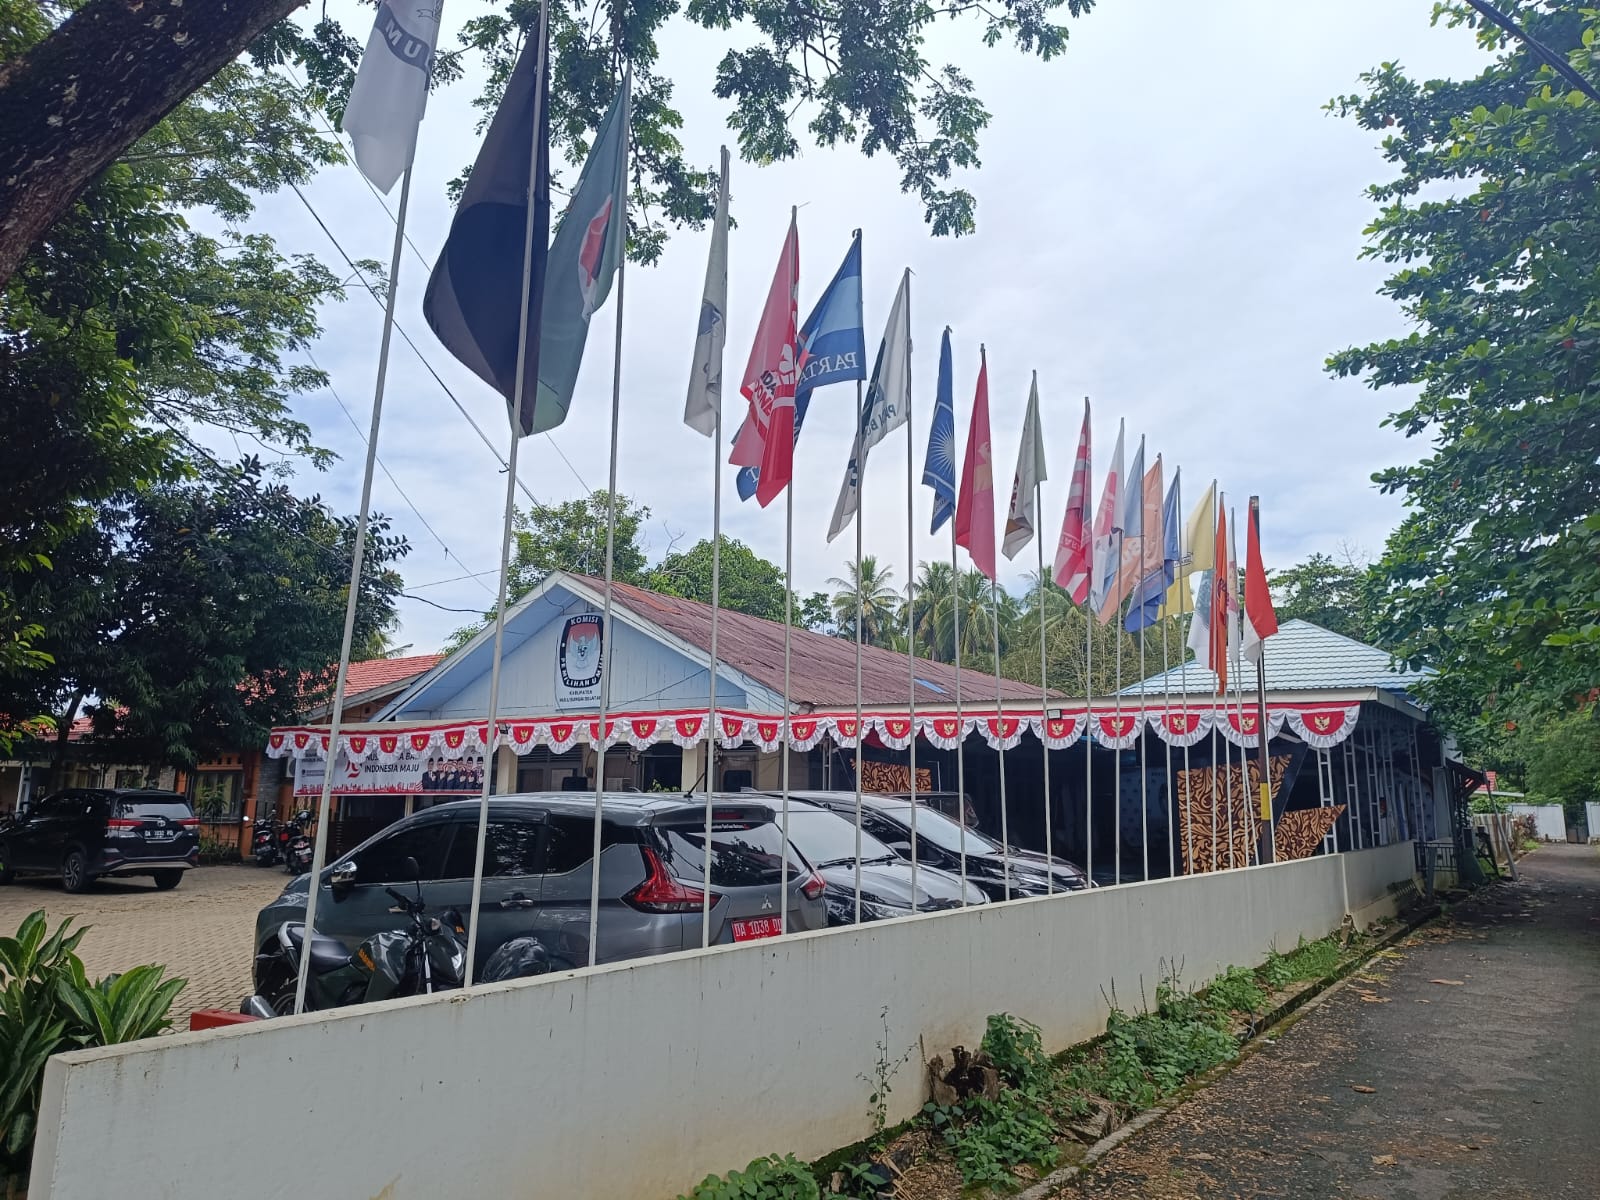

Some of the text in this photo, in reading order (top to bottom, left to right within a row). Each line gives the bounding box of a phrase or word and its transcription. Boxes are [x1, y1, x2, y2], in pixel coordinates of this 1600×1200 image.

[570, 616, 598, 625] KOMISI
[560, 657, 590, 687] PEMILIHAN
[365, 763, 420, 773] INDONESIA MAJU
[733, 922, 746, 937] DA
[749, 920, 770, 935] 1038
